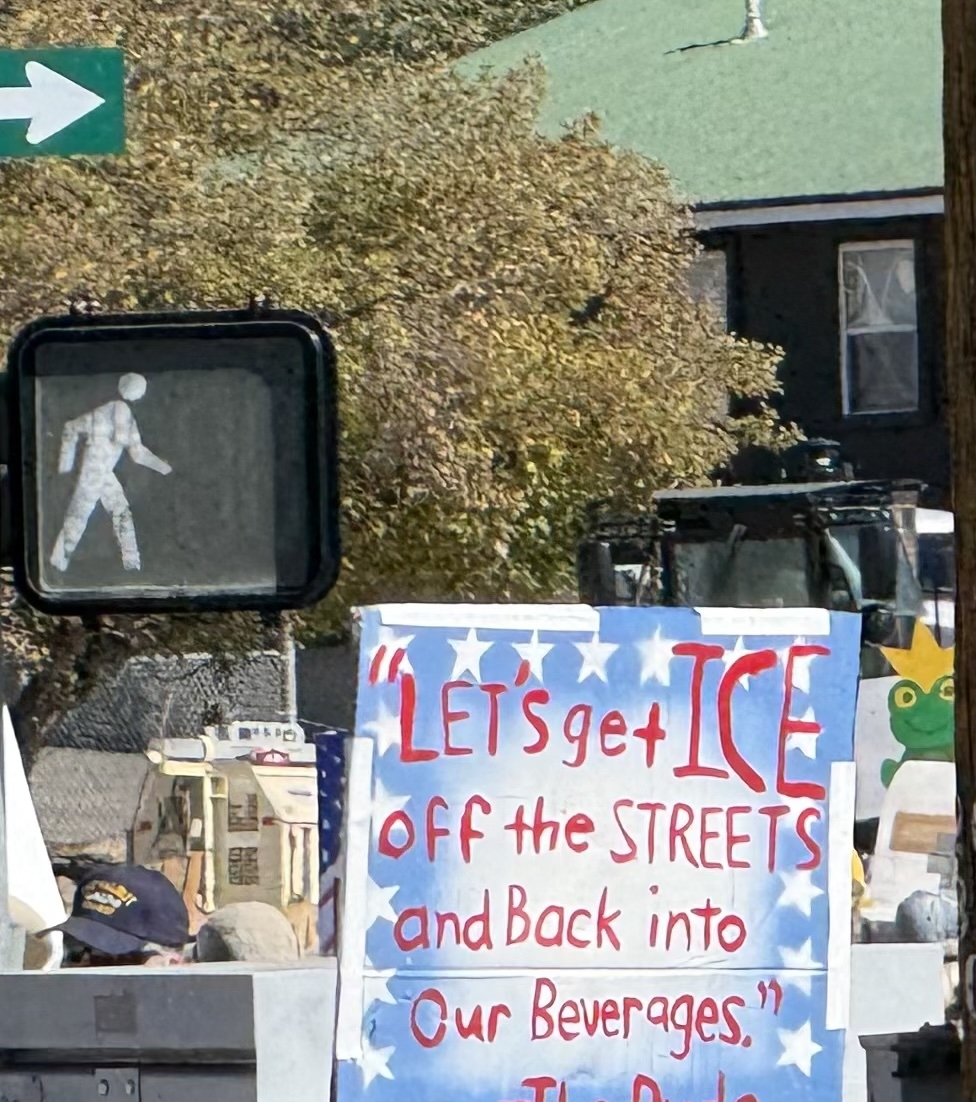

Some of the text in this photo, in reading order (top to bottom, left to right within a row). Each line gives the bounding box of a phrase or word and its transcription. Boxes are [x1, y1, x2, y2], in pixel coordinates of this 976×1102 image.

[562, 703, 666, 768] get
[673, 643, 831, 800] ICE
[504, 796, 595, 853] the
[610, 799, 822, 873] STREETS
[393, 885, 747, 953] and Back into
[410, 988, 511, 1048] Our
